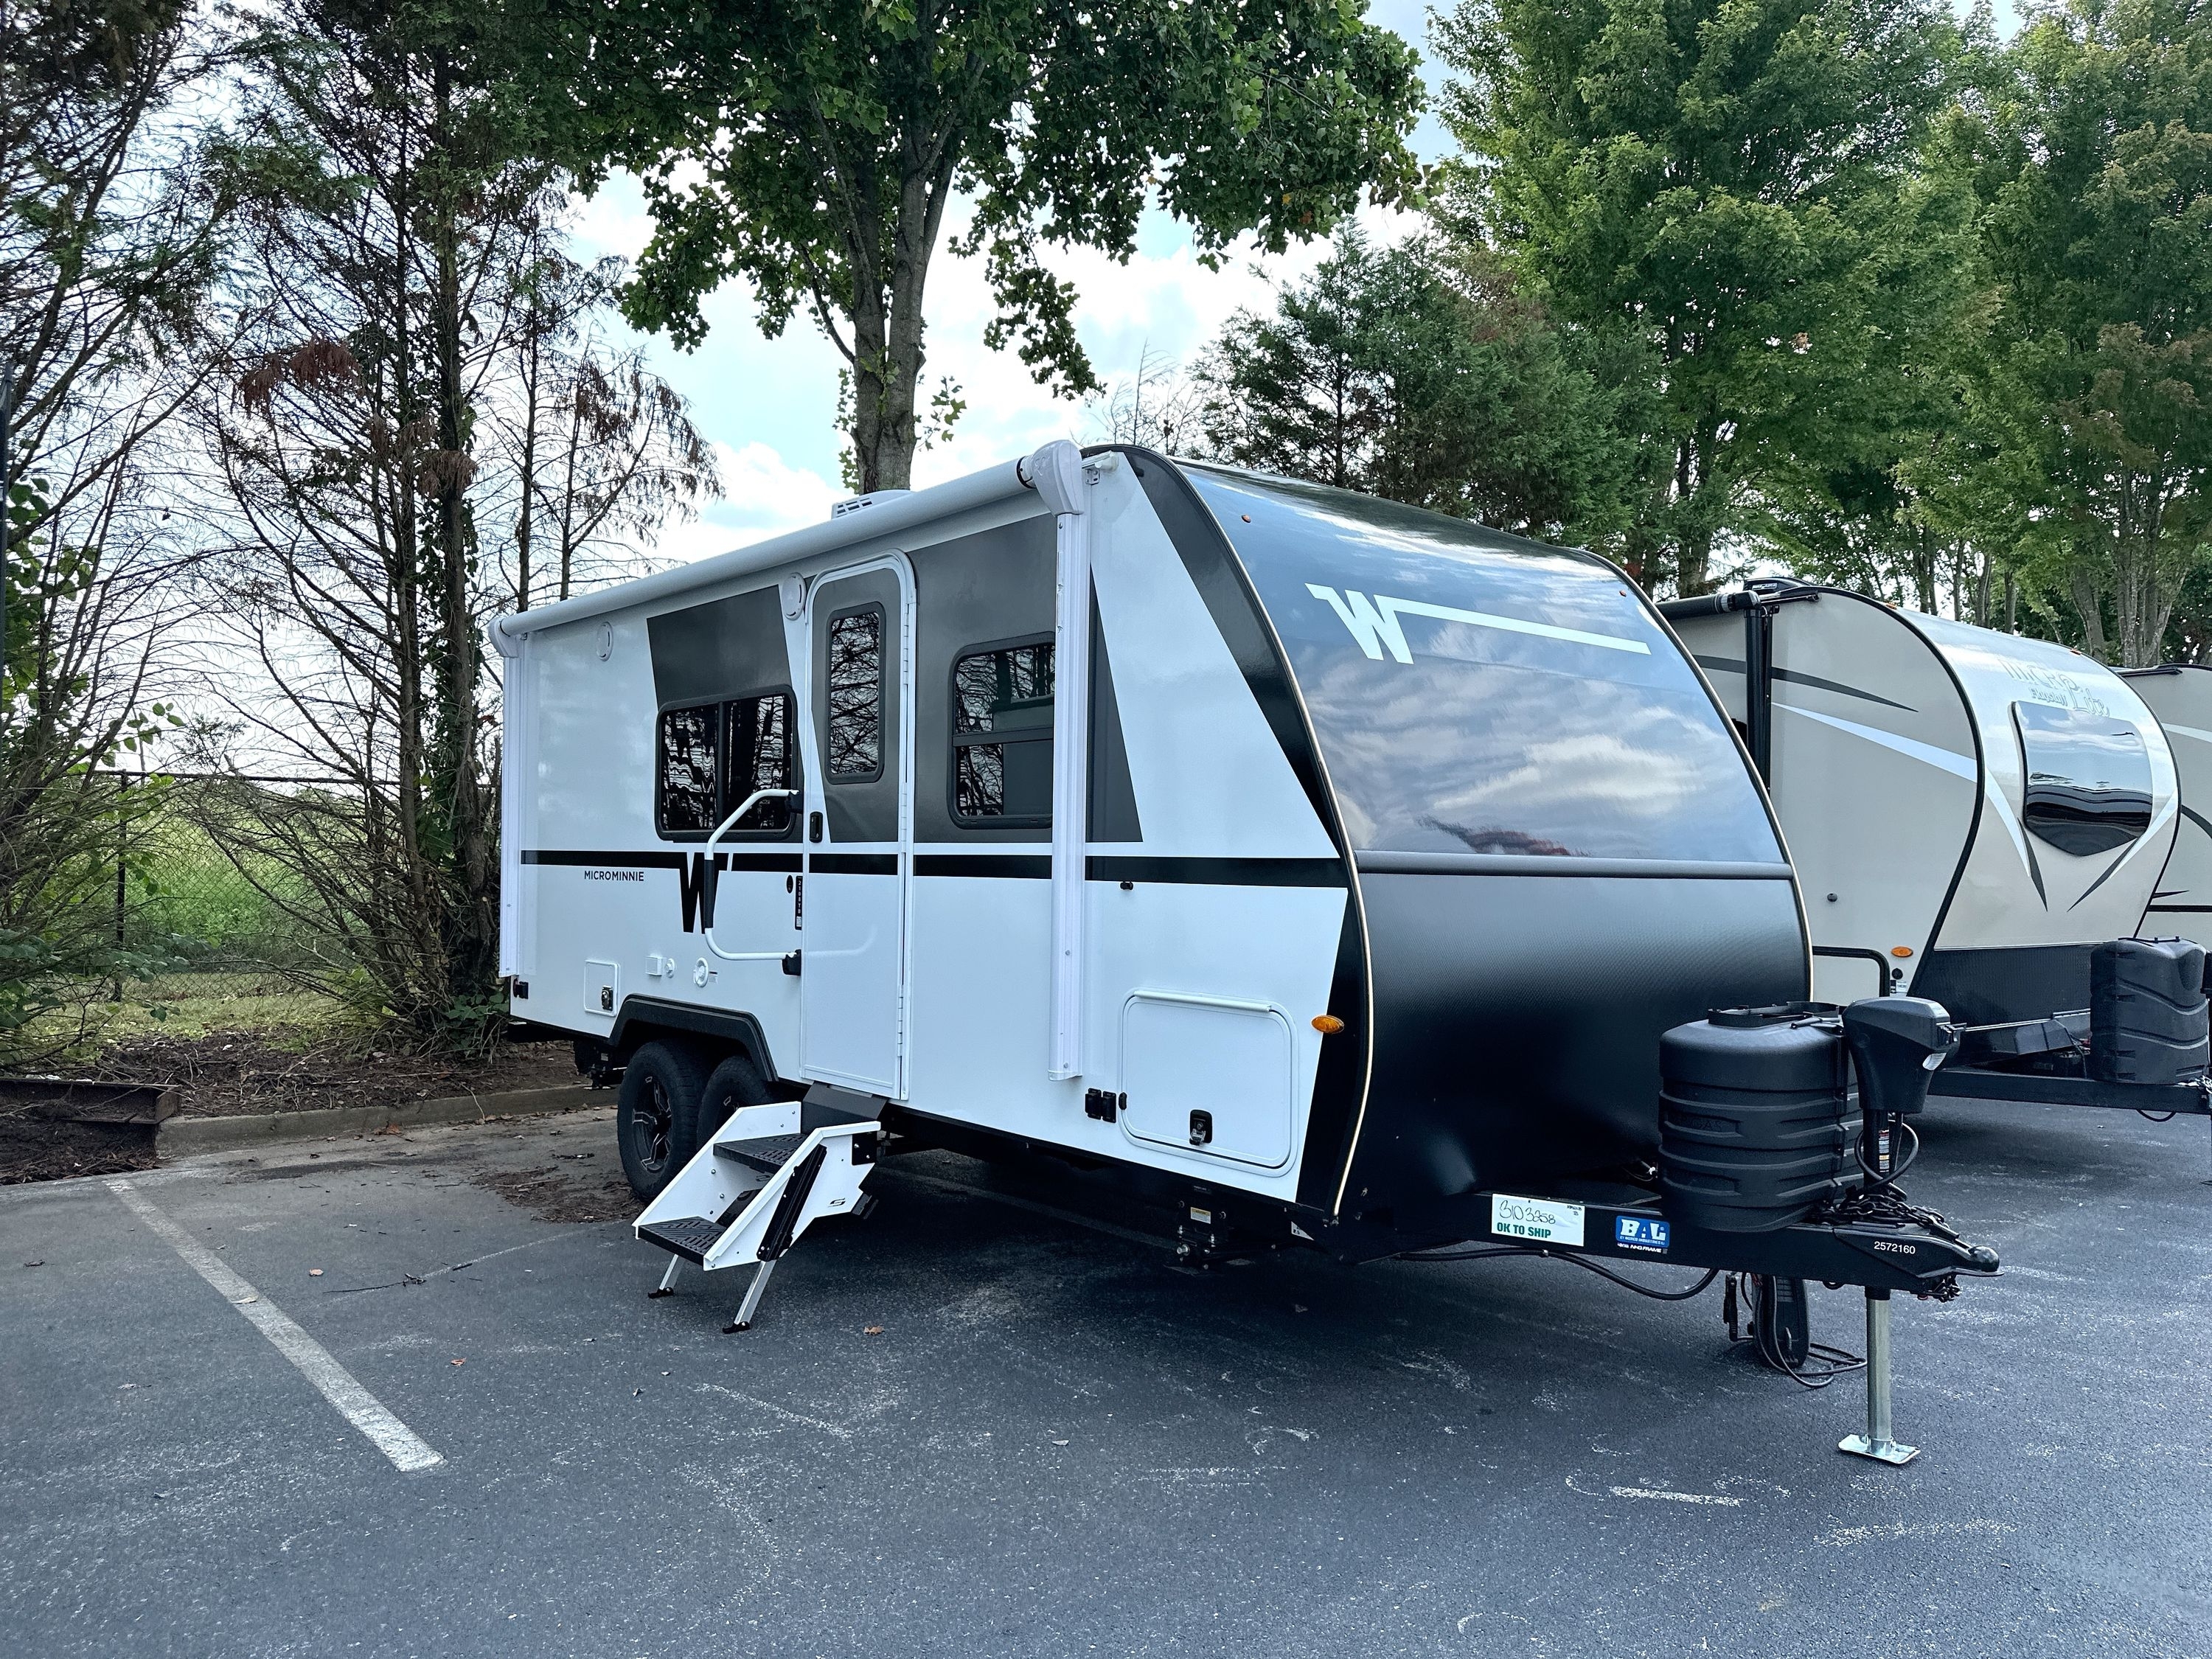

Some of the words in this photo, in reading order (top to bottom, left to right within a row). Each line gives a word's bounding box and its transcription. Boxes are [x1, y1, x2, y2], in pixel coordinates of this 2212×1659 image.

[2062, 678, 2110, 717] Lite
[584, 870, 644, 882] MICROMINNIE
[1497, 1222, 1511, 1234] OK
[1513, 1224, 1525, 1235] TO
[1528, 1226, 1551, 1238] SHIP
[1621, 1219, 1666, 1241] BAL
[1874, 1241, 1916, 1254] 2572160
